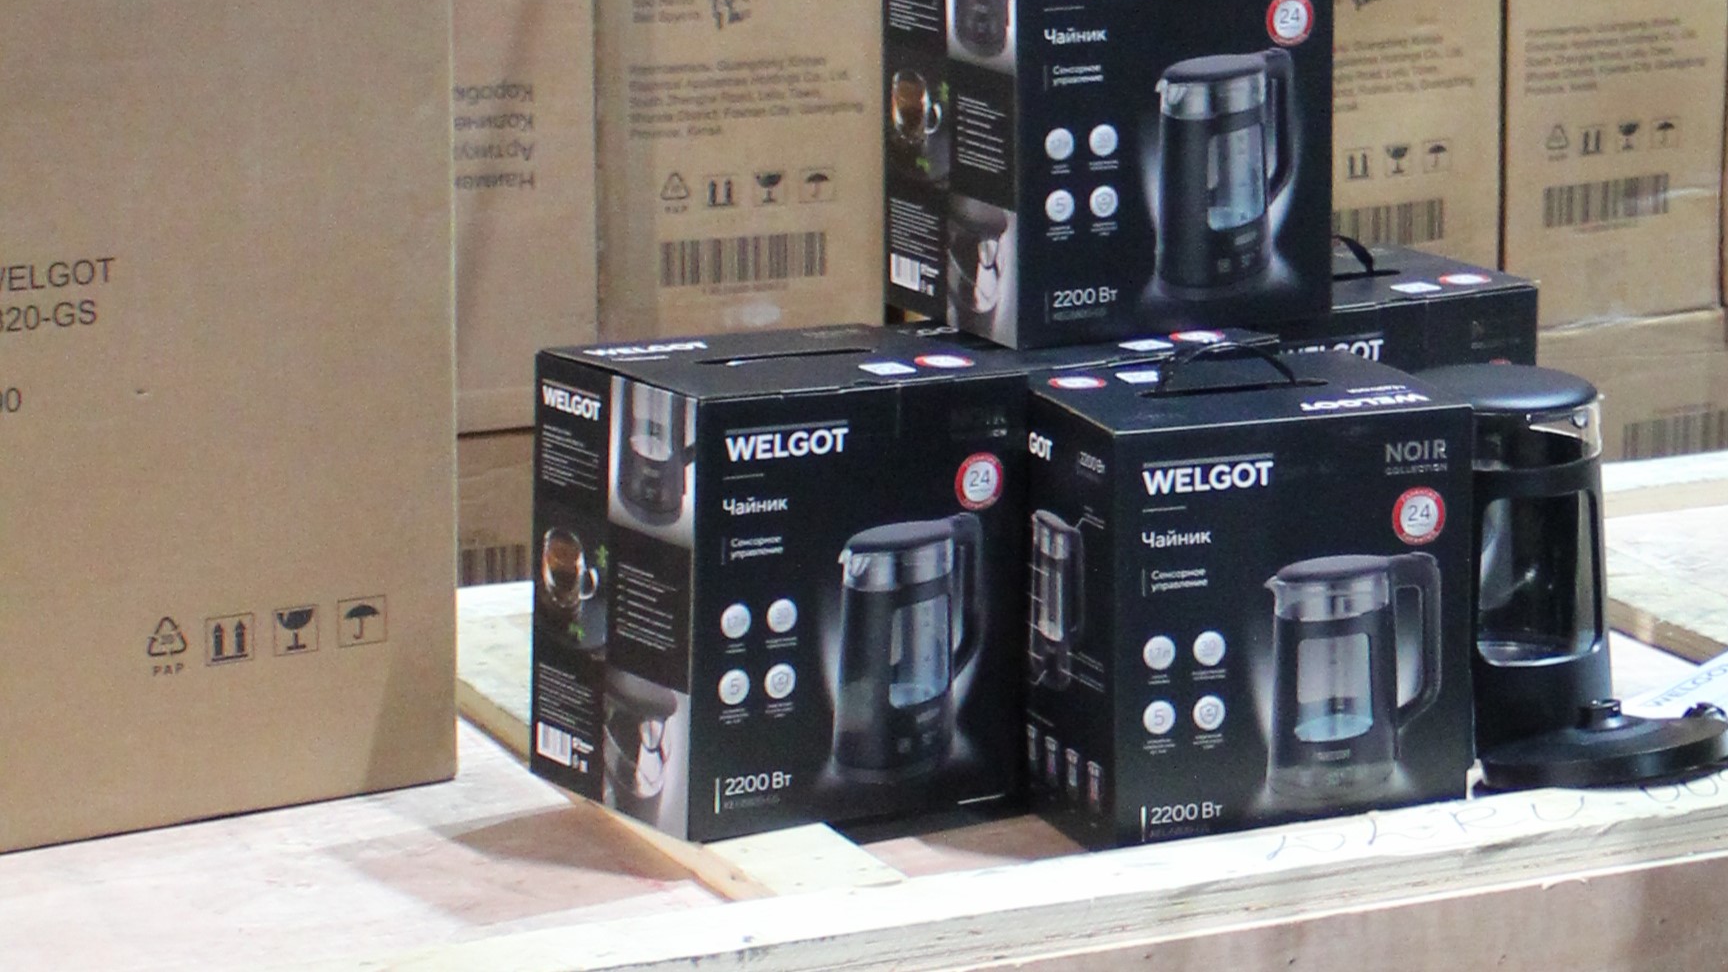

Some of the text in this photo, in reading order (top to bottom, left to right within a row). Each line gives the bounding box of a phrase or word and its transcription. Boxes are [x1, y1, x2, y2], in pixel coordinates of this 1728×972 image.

[1280, 7, 1300, 24] 24
[1044, 27, 1107, 46] Чайник
[1055, 197, 1066, 214] 5
[0, 256, 116, 292] ELGOT
[1053, 286, 1118, 308] 2200 Вт
[0, 388, 22, 413] 0
[542, 384, 602, 422] WELGOT
[726, 428, 849, 462] WELGOT
[1028, 432, 1053, 462] GOT
[1384, 438, 1447, 463] NOIR
[969, 469, 991, 488] 24
[1142, 461, 1274, 495] WELGOT
[722, 497, 788, 516] Чайник
[1407, 503, 1430, 522] 24
[730, 535, 783, 548] Сенсорное
[1142, 530, 1212, 549] Чайник
[1151, 568, 1206, 581] Сенсорное
[1151, 578, 1208, 593] управление
[152, 662, 184, 677] PAP
[730, 679, 740, 696] 5
[1154, 708, 1165, 727] 5
[725, 771, 792, 796] 2200 Вт
[1150, 801, 1224, 825] 2200 Вт
